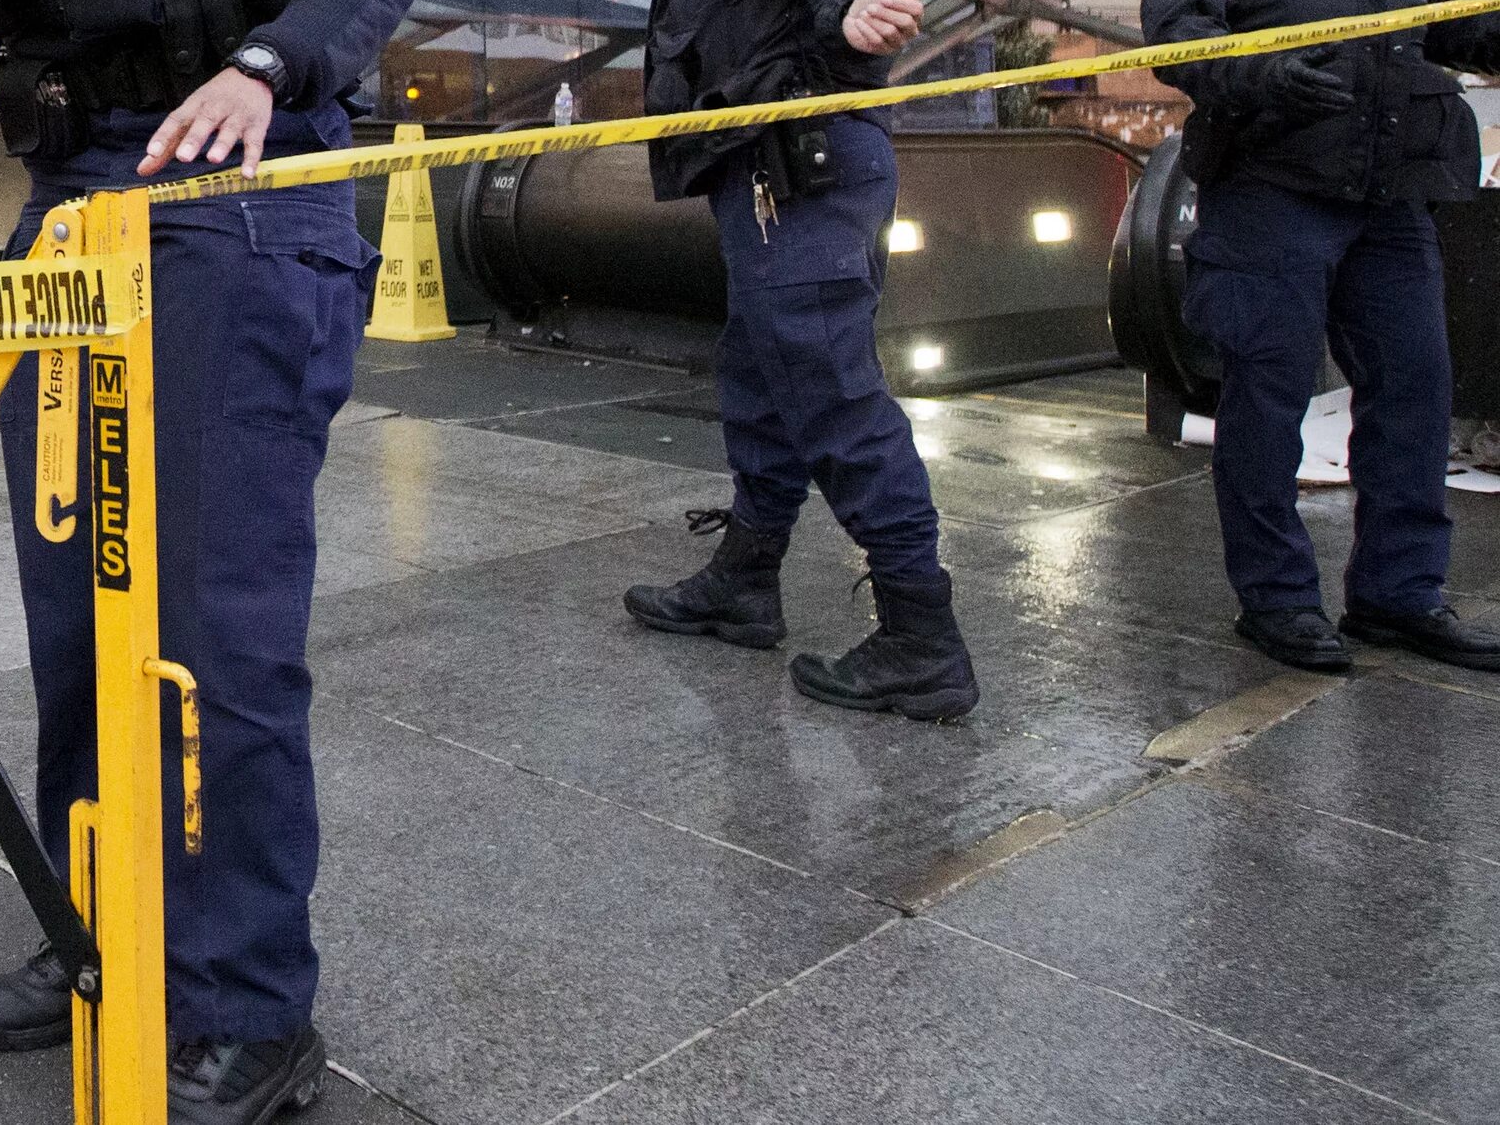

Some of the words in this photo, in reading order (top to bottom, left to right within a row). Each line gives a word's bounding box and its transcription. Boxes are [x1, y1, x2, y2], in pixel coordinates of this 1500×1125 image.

[492, 176, 515, 189] N02
[385, 259, 403, 275] WET
[418, 259, 433, 277] WET
[381, 280, 407, 299] FLOOR
[416, 281, 439, 299] FLOOR
[22, 270, 107, 339] POLICE
[96, 361, 122, 395] M
[96, 395, 122, 405] metro
